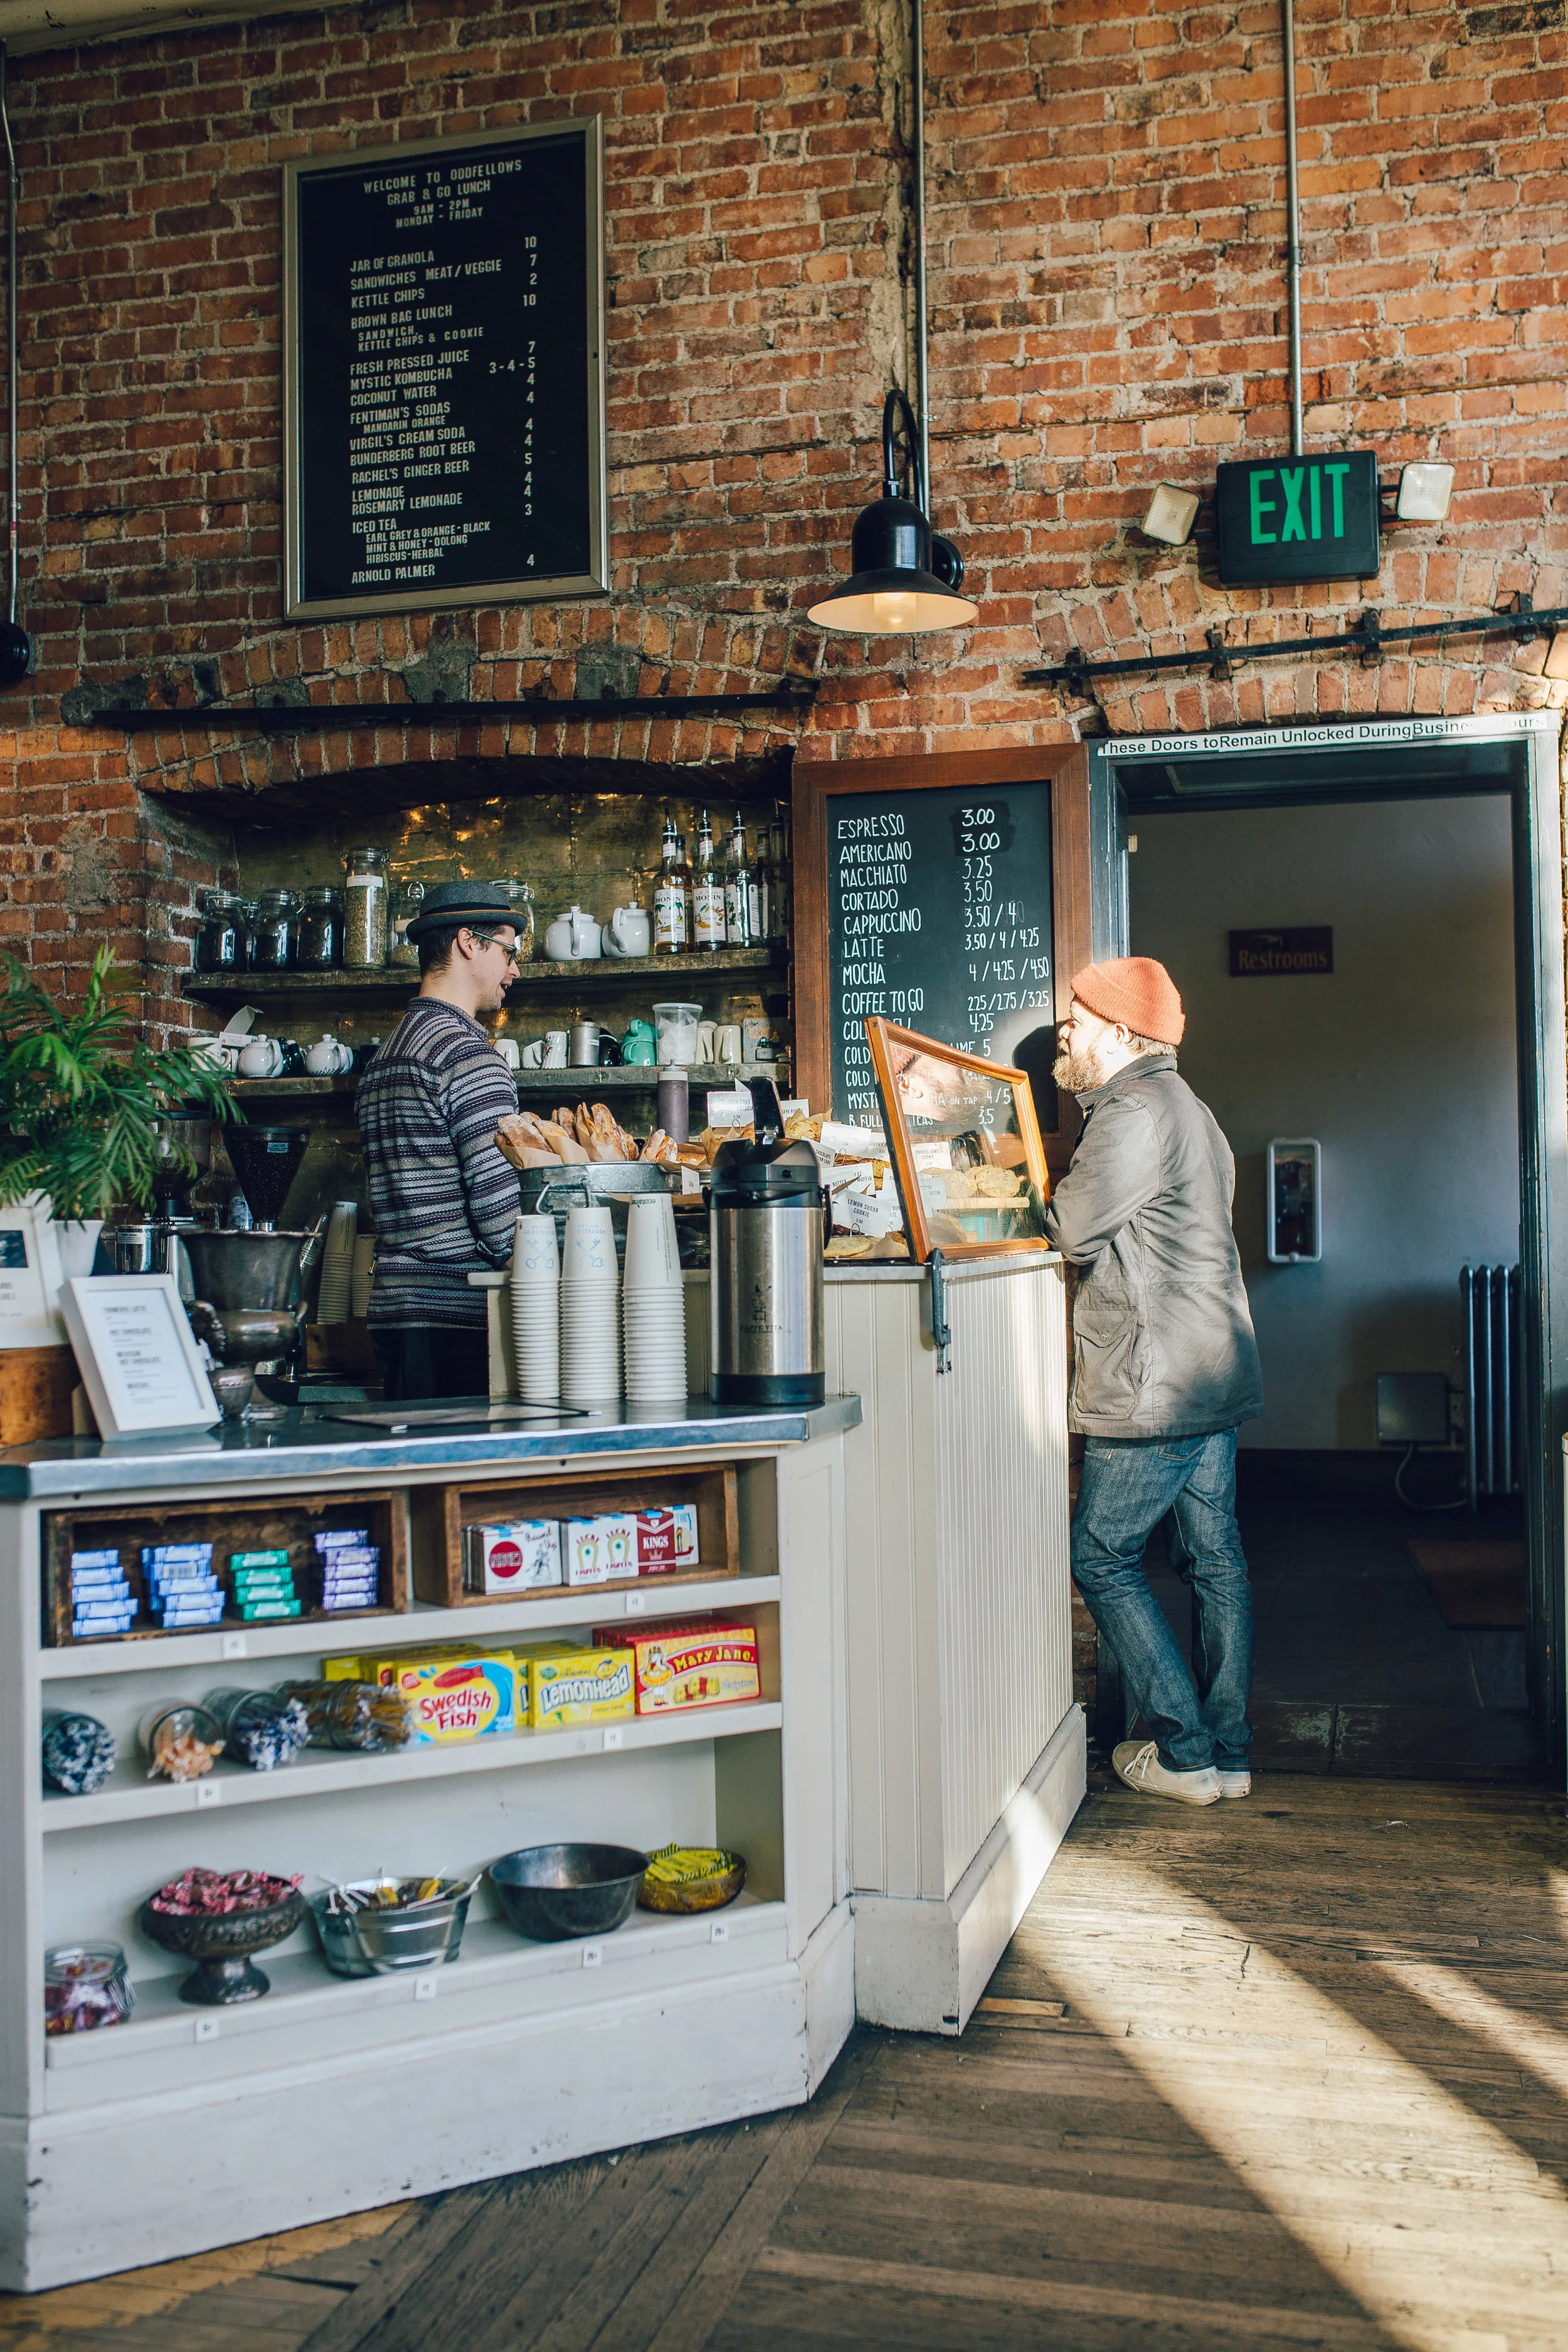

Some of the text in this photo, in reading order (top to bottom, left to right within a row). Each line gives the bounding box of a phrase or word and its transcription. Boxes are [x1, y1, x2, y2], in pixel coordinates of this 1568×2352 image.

[364, 159, 522, 193] WELCOME TO ODDFELLOWS
[388, 191, 415, 205] GRAB
[437, 186, 450, 198] GO
[458, 179, 490, 195] LUNCH
[396, 207, 483, 228] MONDAY FRIDAY
[414, 198, 469, 215] 9AM 2PM
[350, 236, 537, 272] JAR OF GRANOLA 10
[351, 271, 416, 290] SANDWICHES
[426, 265, 453, 280] MEAT
[465, 259, 502, 275] VEGGIE
[530, 254, 537, 267] 7
[351, 273, 537, 308] KETTLE CHIPS 2
[351, 294, 536, 329] BROWN BAG LUNCH 10
[358, 339, 391, 352] KETTLE
[395, 334, 423, 347] CHIPS
[444, 327, 484, 341] COOKIE
[351, 341, 536, 376] FRESH PRESSED JUICE 7
[351, 375, 391, 390] MYSTIC
[395, 368, 452, 385] KOMBUCHA
[351, 373, 534, 406] COCONUT WATER 4
[351, 391, 534, 425] FENTIMAN'S SODAS 4
[350, 418, 533, 450] VIRGIL'S CREAM SODA 4
[364, 415, 445, 433] MANDARIN ORANGE
[351, 434, 532, 466] BUNDERBERG ROOT BEER 4
[352, 453, 532, 484] RACHEL'S GINGER BEER 5
[352, 471, 532, 502] LEMONADE 4
[352, 485, 532, 516] ROSEMARY LEMONADE 4
[1249, 463, 1350, 545] EXIT
[352, 504, 532, 534] ICED TEA 3
[366, 532, 387, 543] EARL
[390, 529, 411, 540] GREY
[421, 525, 455, 537] ORANGE
[463, 521, 490, 533] BLACK
[366, 543, 387, 554] MINT
[399, 538, 426, 550] HONEY
[435, 534, 467, 546] OOLONG
[352, 554, 534, 584] ARNOLD PALMER 4
[1152, 739, 1198, 751] Doors
[1282, 726, 1354, 743] Unlocked
[837, 808, 995, 839] ESPRESSO 3.00
[839, 832, 1000, 864] AMERICANO 3.00
[840, 855, 992, 887] MACCHIATO 3.25
[655, 896, 681, 904] MONIN
[842, 880, 992, 911] CORTADO 3.50
[844, 908, 921, 935] CAPPUCCINO
[965, 905, 990, 928] 3.50
[844, 936, 884, 958] LATTE
[1238, 949, 1328, 971] Restrooms
[843, 961, 886, 986] MOCHA
[842, 992, 887, 1015] COFFEE
[889, 991, 905, 1012] TO
[908, 988, 923, 1012] GO
[843, 1021, 867, 1041] COL
[970, 1013, 994, 1033] 4.25
[983, 1039, 991, 1057] 5
[845, 1069, 870, 1087] COLD
[950, 1098, 960, 1106] ON
[963, 1096, 977, 1104] TAP
[832, 1179, 847, 1187] BUTTER
[847, 1199, 879, 1214] LEMON SUGAR
[853, 1207, 871, 1218] COOKIE
[643, 1535, 669, 1550] KINGS
[419, 1688, 493, 1721] Swedish
[436, 1708, 478, 1735] Fish
